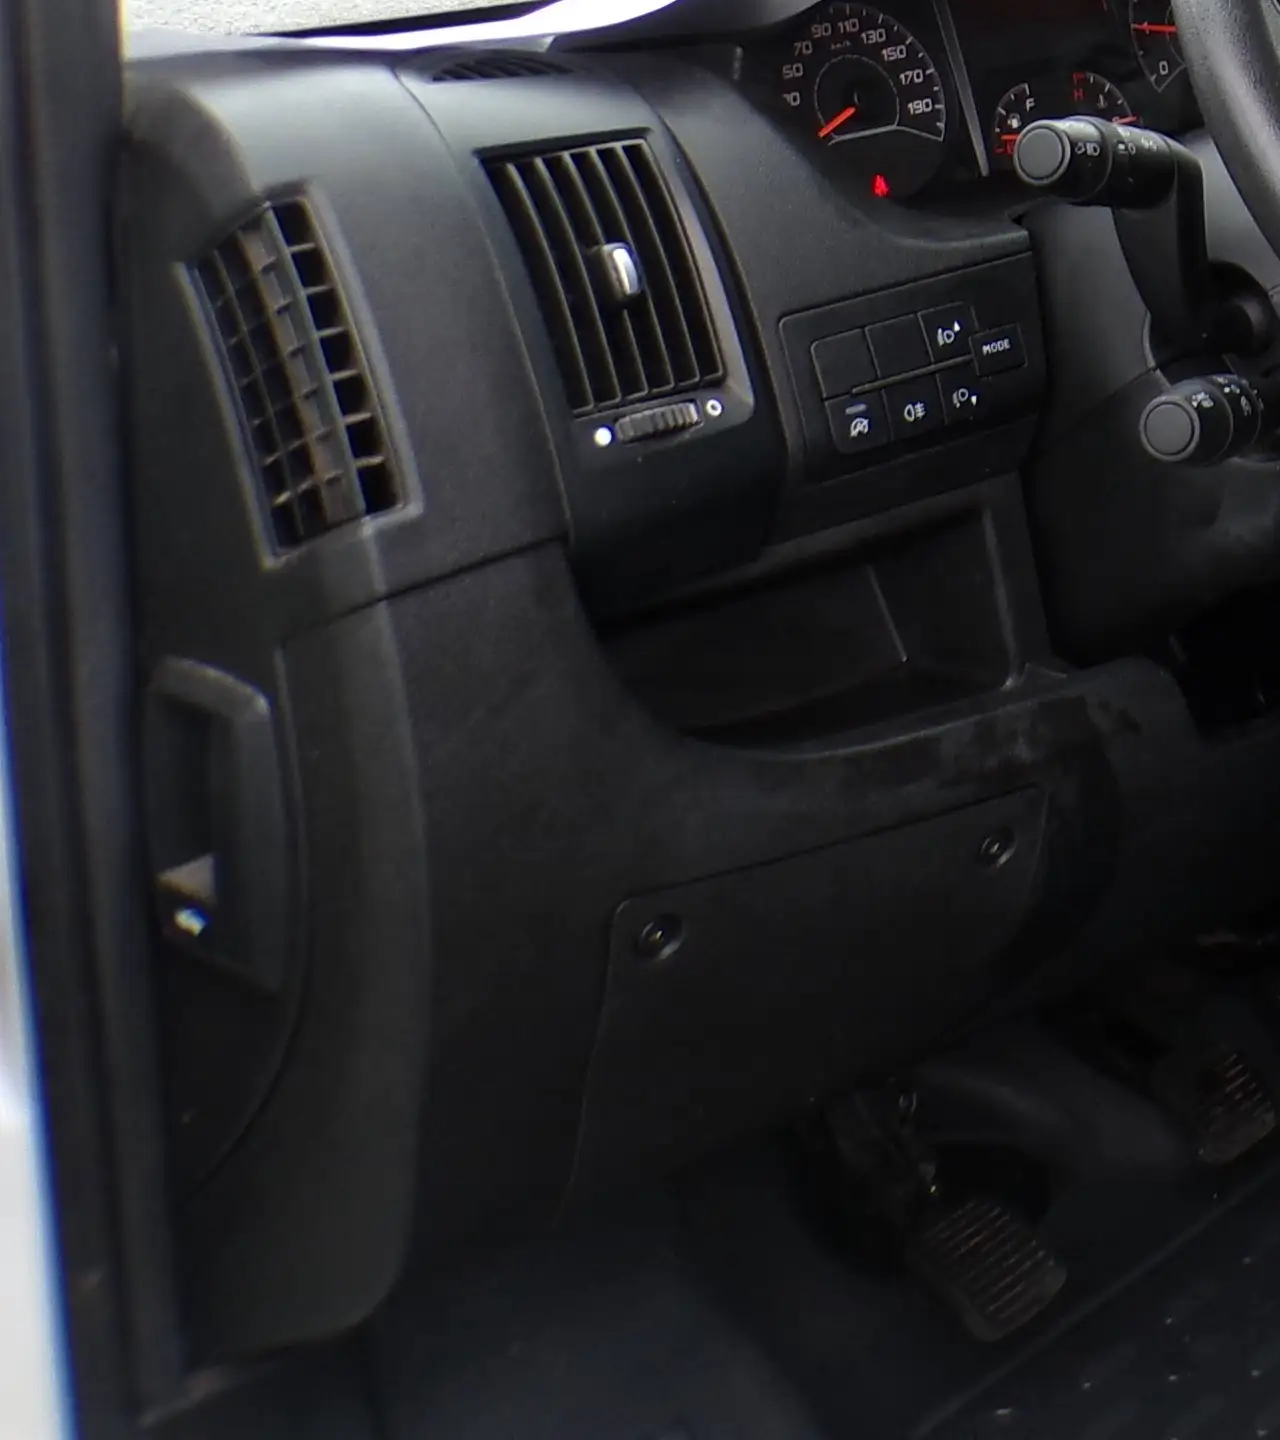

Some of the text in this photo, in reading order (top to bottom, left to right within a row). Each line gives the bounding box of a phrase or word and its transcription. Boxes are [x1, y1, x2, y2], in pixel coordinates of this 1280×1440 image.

[811, 23, 832, 38] 90
[837, 18, 860, 34] 110
[861, 28, 886, 44] 130
[793, 41, 813, 56] 70
[881, 45, 907, 61] 150
[782, 63, 803, 80] 50
[899, 68, 923, 85] 170
[907, 98, 933, 115] 190
[1026, 97, 1036, 111] F
[982, 338, 1011, 356] MODE
